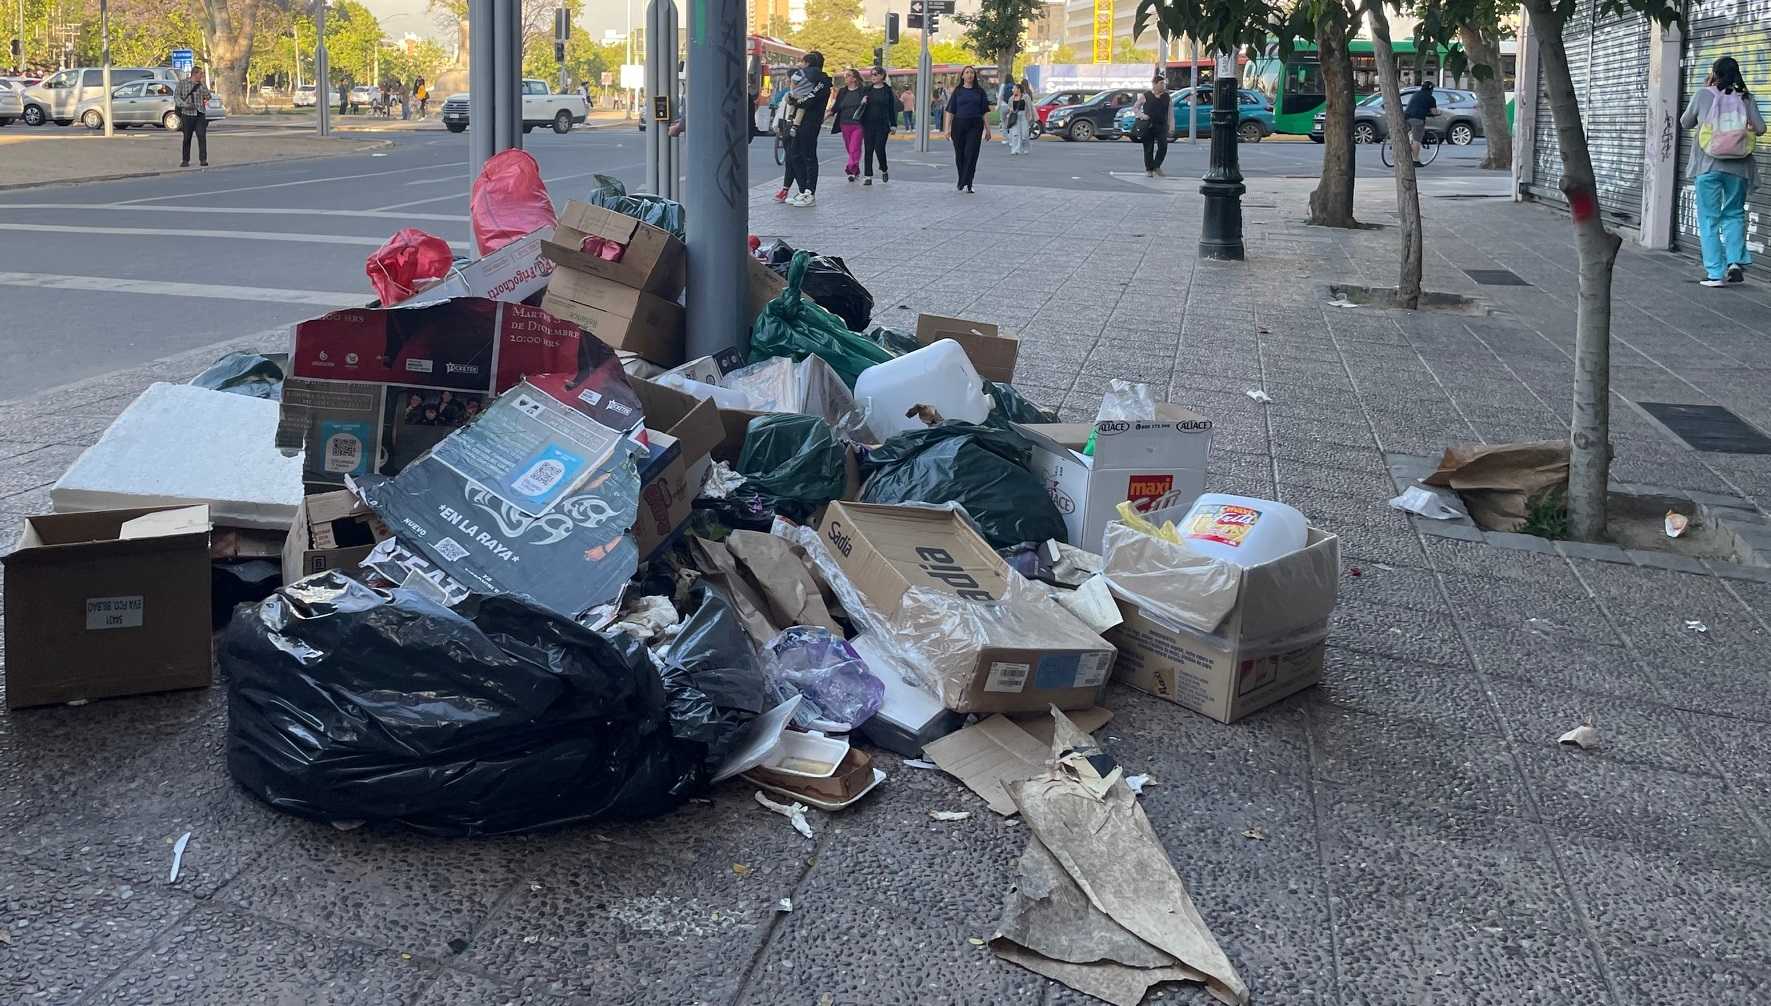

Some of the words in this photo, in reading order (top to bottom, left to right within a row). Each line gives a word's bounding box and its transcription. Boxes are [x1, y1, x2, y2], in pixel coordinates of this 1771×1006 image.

[510, 335, 541, 344] 20:00
[1099, 422, 1126, 432] ALIACE
[1181, 421, 1209, 430] ALIACE
[1131, 478, 1172, 496] maxi
[403, 518, 427, 536] NUEVO
[458, 520, 479, 537] LA
[828, 521, 853, 558] Sadia
